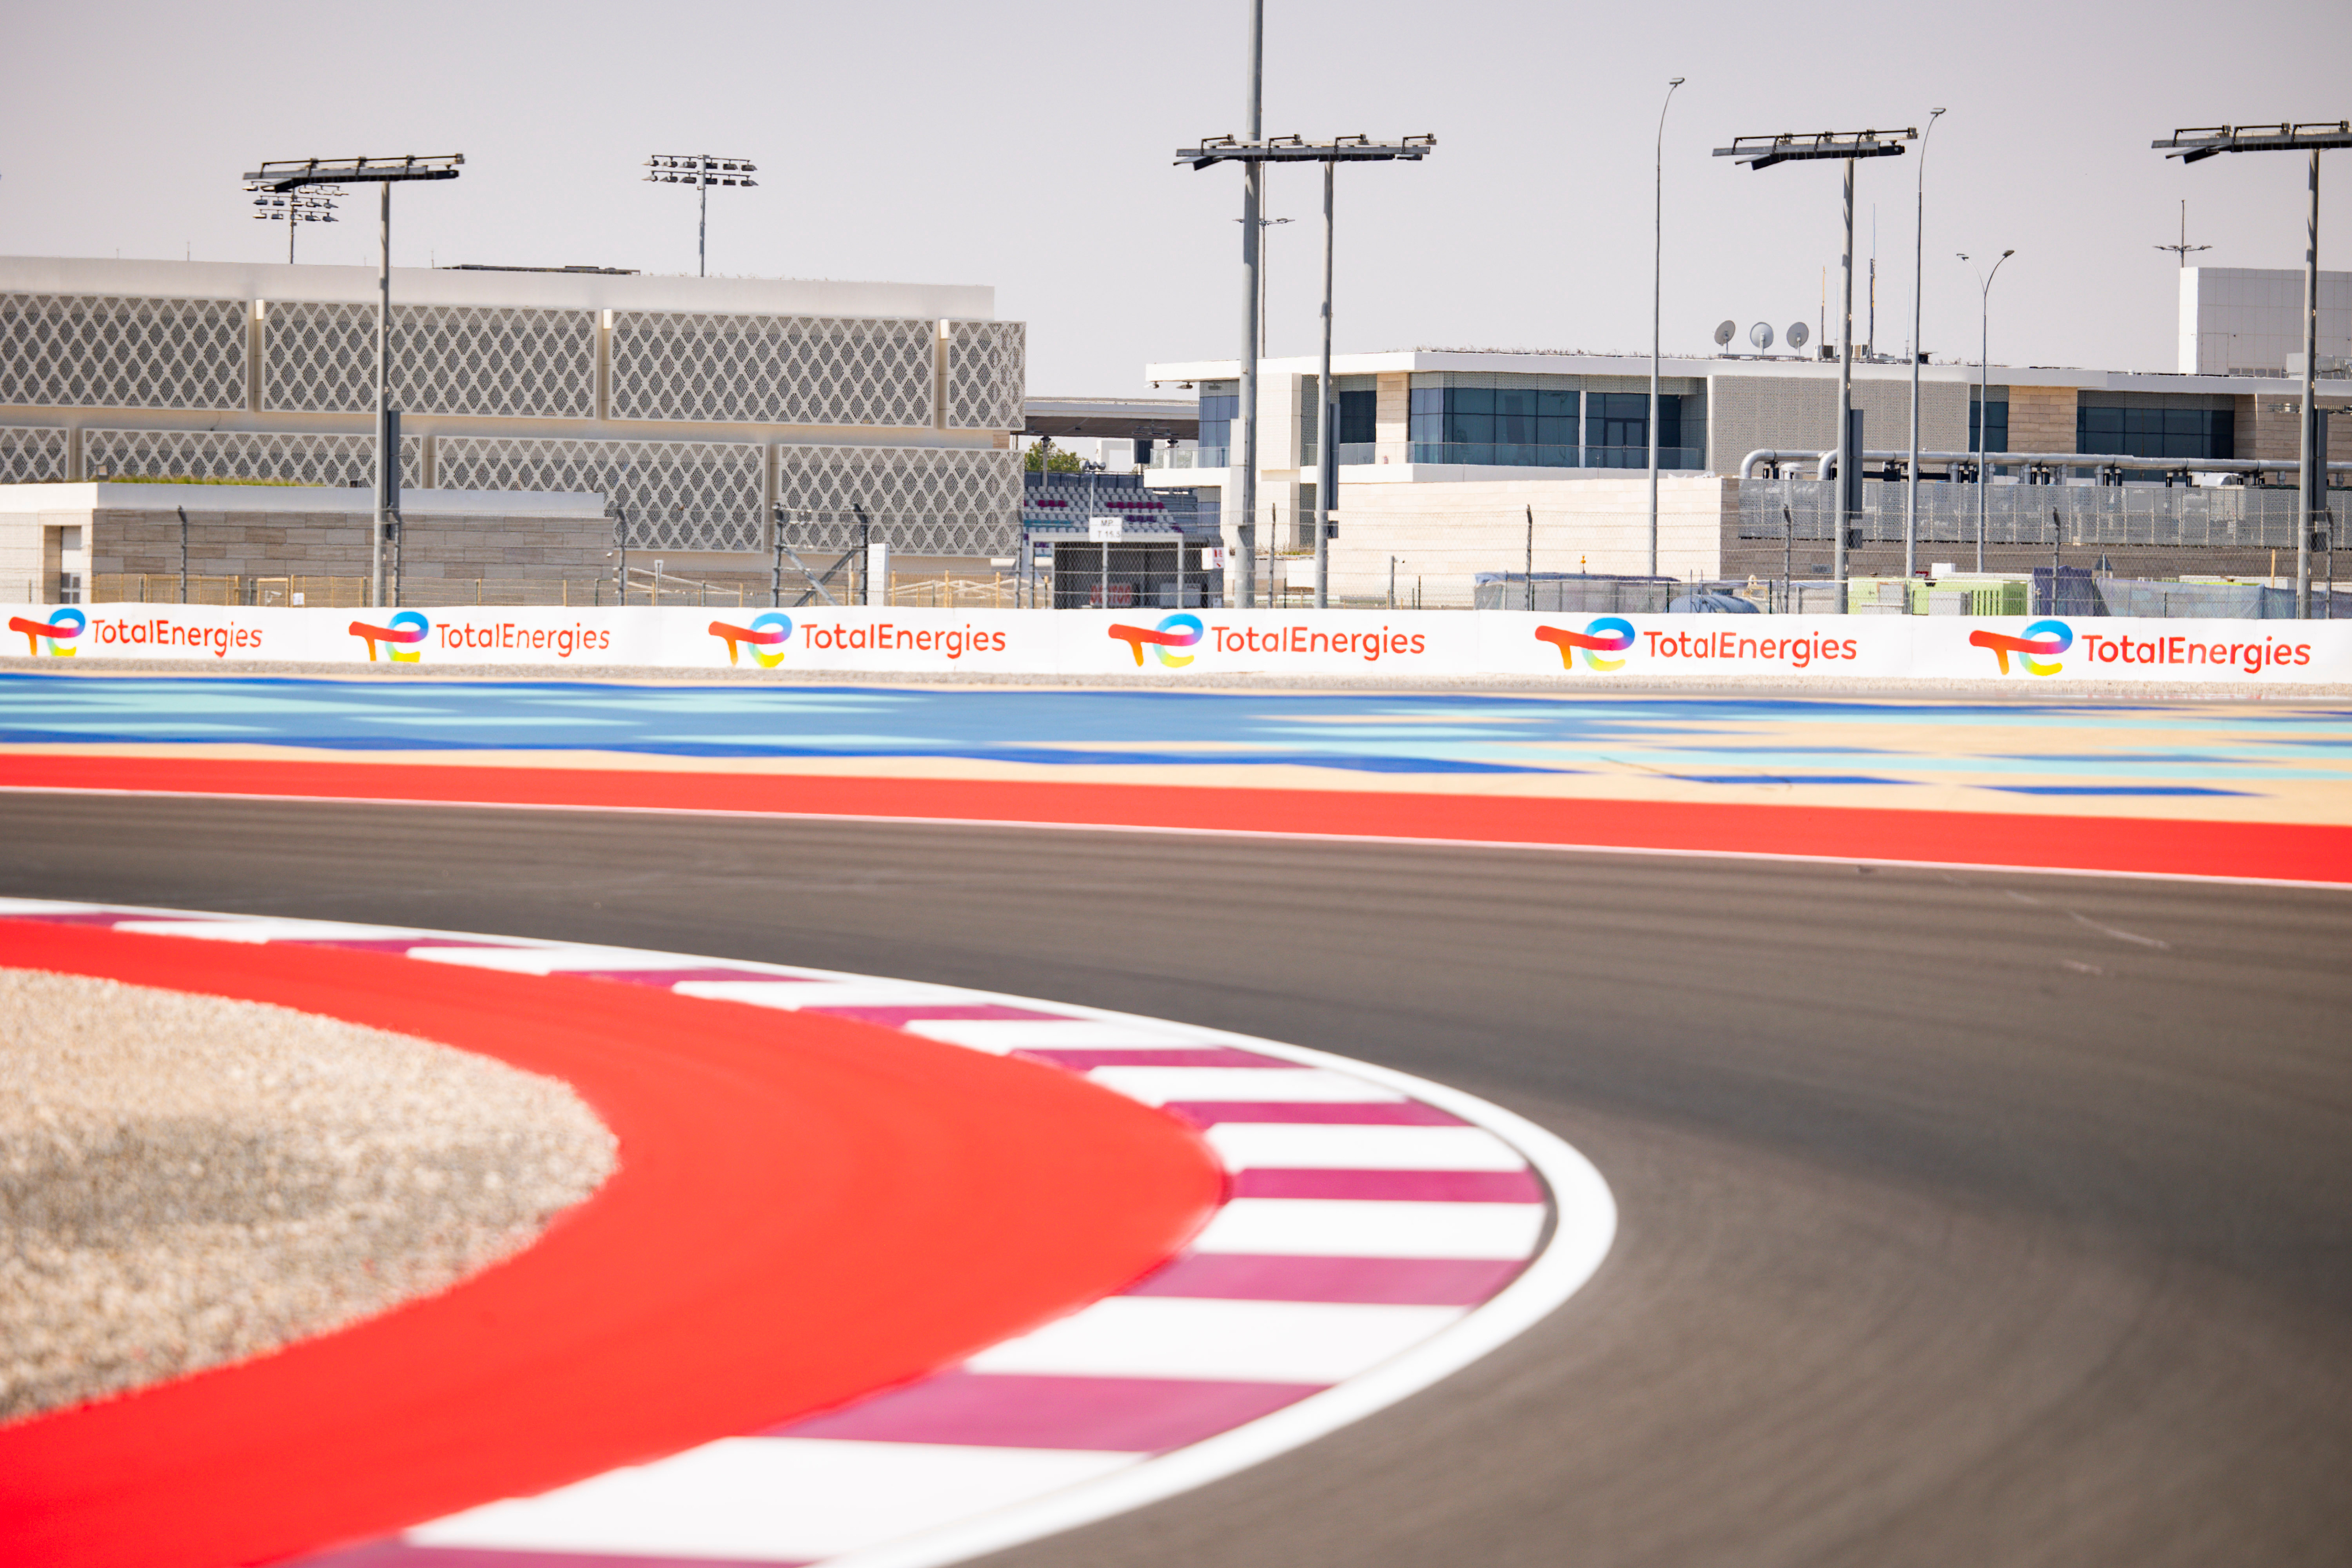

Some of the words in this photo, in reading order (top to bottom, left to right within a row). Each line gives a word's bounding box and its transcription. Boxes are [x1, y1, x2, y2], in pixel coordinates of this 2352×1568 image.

[92, 618, 262, 658] TotalEnergies
[436, 622, 610, 657] TotalEnergies
[800, 623, 1005, 659] TotalEnergies
[1212, 625, 1425, 661] TotalEnergies
[1643, 630, 1857, 668] TotalEnergies
[2082, 634, 2311, 674] TotalEnergies
